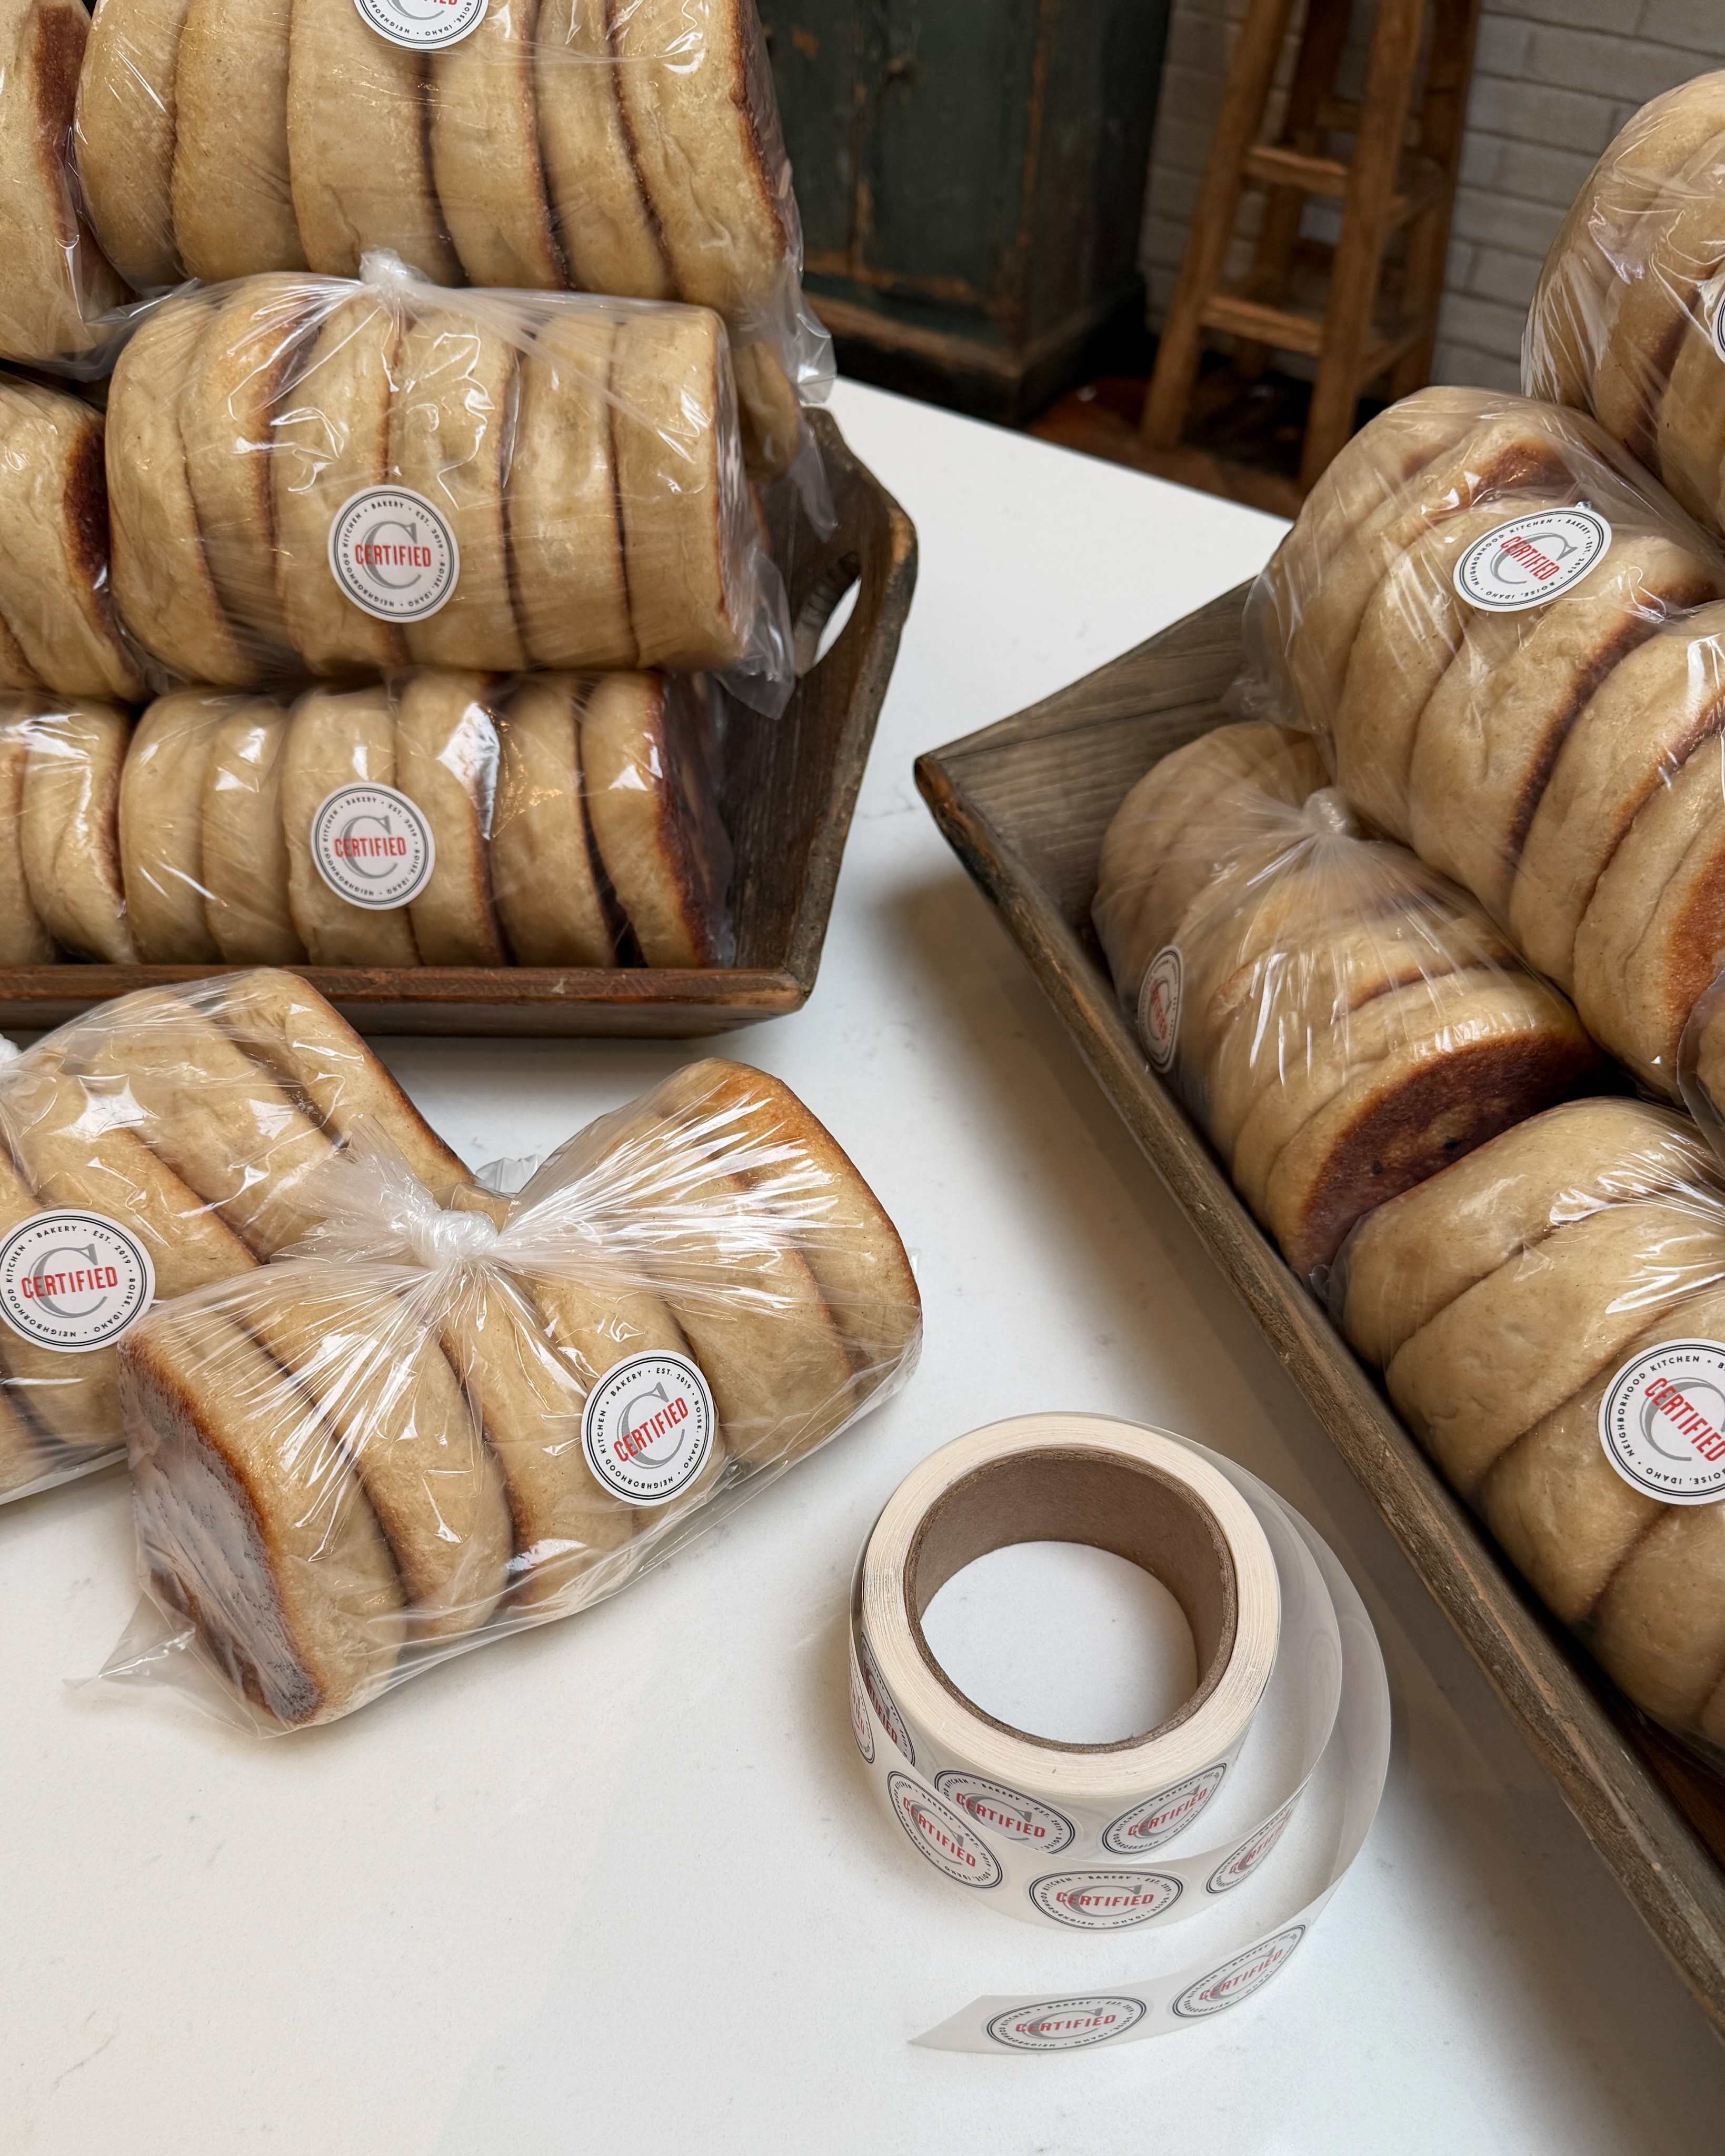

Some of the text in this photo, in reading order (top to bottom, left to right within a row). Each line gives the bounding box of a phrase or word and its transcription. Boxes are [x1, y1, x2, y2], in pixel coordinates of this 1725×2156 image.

[425, 24, 452, 36] IDAHO
[454, 2, 472, 23] BOISE,
[1509, 519, 1553, 534] KITCHEN
[1566, 519, 1591, 535] BAKERY
[1582, 541, 1593, 555] EST.
[342, 501, 445, 607] NEIGHBORHOOD KITCHEN BAKERY EST. 2019 BOISE, IDAHO
[354, 544, 432, 567] CERTIFIED
[361, 521, 422, 590] C
[1470, 534, 1504, 586] NEIGHBORHOOD
[1490, 533, 1578, 584] C
[1500, 536, 1560, 581] CERTIFIED
[1568, 558, 1584, 574] 2019
[333, 837, 407, 858] CERTIFIED
[340, 815, 398, 879] C
[6, 1225, 135, 1337] NEIGHBORHOOD KITCHEN BAKERY EST. 2019 BOISE, IDAHO
[21, 1266, 118, 1299] CERTIFIED
[28, 1243, 108, 1318] C
[610, 1371, 642, 1396] BAKERY
[656, 1368, 672, 1376] EST.
[676, 1374, 691, 1389] 2019
[1650, 1355, 1700, 1371] KITCHEN
[597, 1410, 607, 1454] KITCHEN
[613, 1397, 689, 1462] CERTIFIED
[617, 1381, 685, 1469] C
[1617, 1372, 1646, 1456] NEIGHBORHOOD
[1639, 1377, 1725, 1461] C
[1644, 1378, 1725, 1461] CERTIFIED
[605, 1459, 673, 1489] NEIGHBORHOOD
[684, 1439, 700, 1469] IDAHO
[1646, 1468, 1682, 1485] IDAHO
[903, 1797, 975, 1867] CERTIFIED
[908, 1800, 964, 1865] C
[956, 1793, 1045, 1838] CERTIFIED
[962, 1793, 1032, 1840] C
[1128, 1788, 1207, 1836] CERTIFIED
[1133, 1784, 1200, 1839] C
[1056, 1892, 1154, 1907] CERTIFIED
[1062, 1884, 1142, 1917] C
[1199, 1949, 1283, 2000] CERTIFIED
[1204, 1945, 1276, 2002] C
[1015, 2014, 1116, 2032] CERTIFIED
[1022, 2007, 1103, 2040] C
